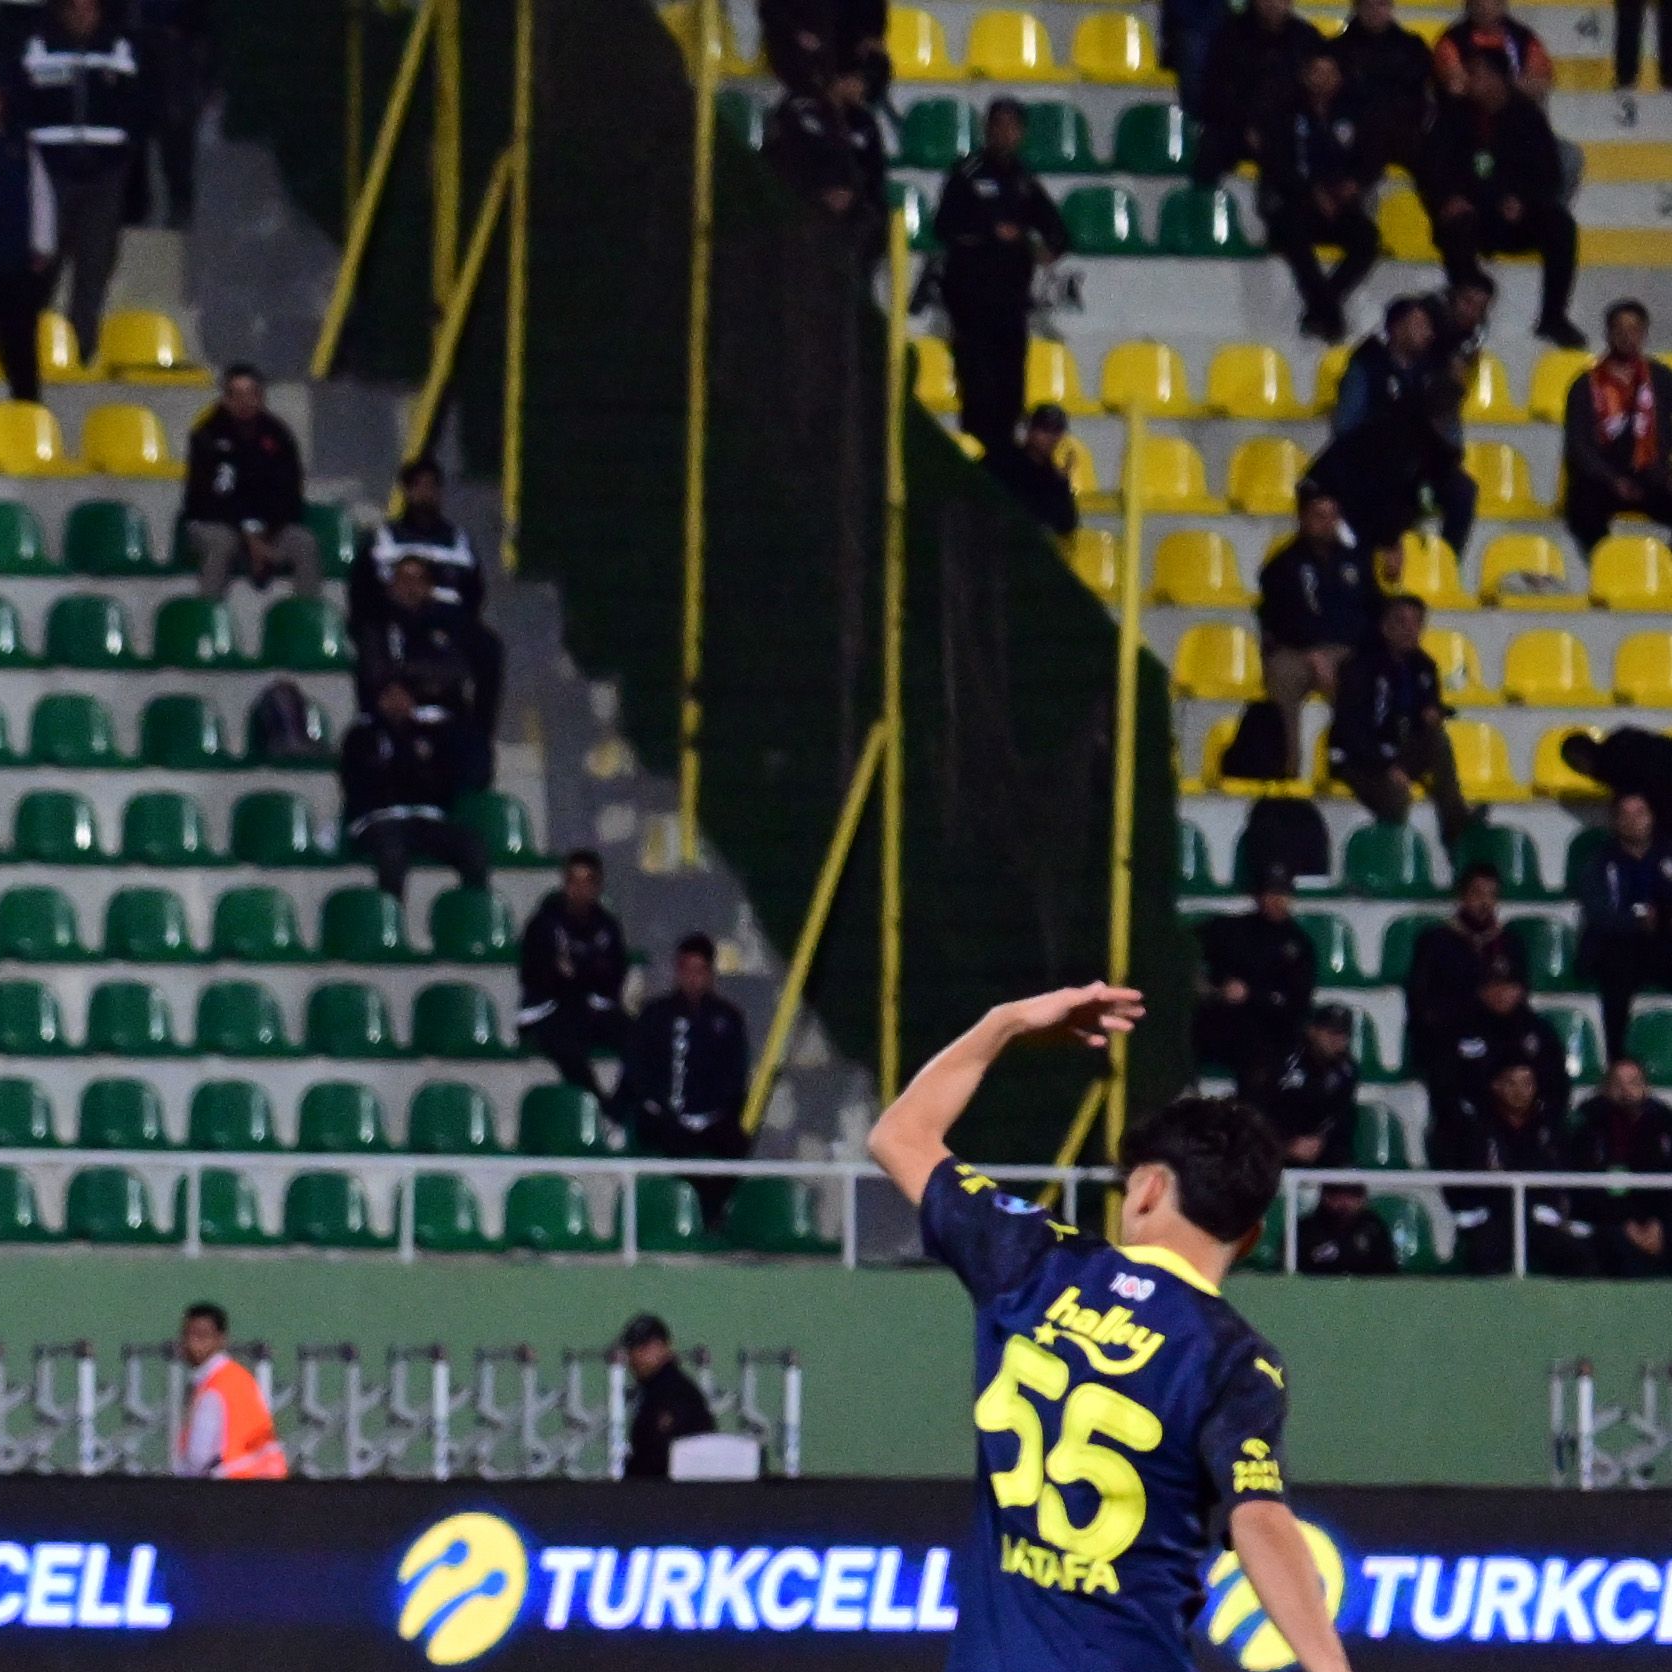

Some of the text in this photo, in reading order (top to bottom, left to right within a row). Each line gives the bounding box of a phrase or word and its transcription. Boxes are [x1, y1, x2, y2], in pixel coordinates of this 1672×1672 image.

[1044, 1286, 1166, 1375] halley
[975, 1333, 1163, 1563] 55
[540, 1545, 958, 1632] TURKCELL
